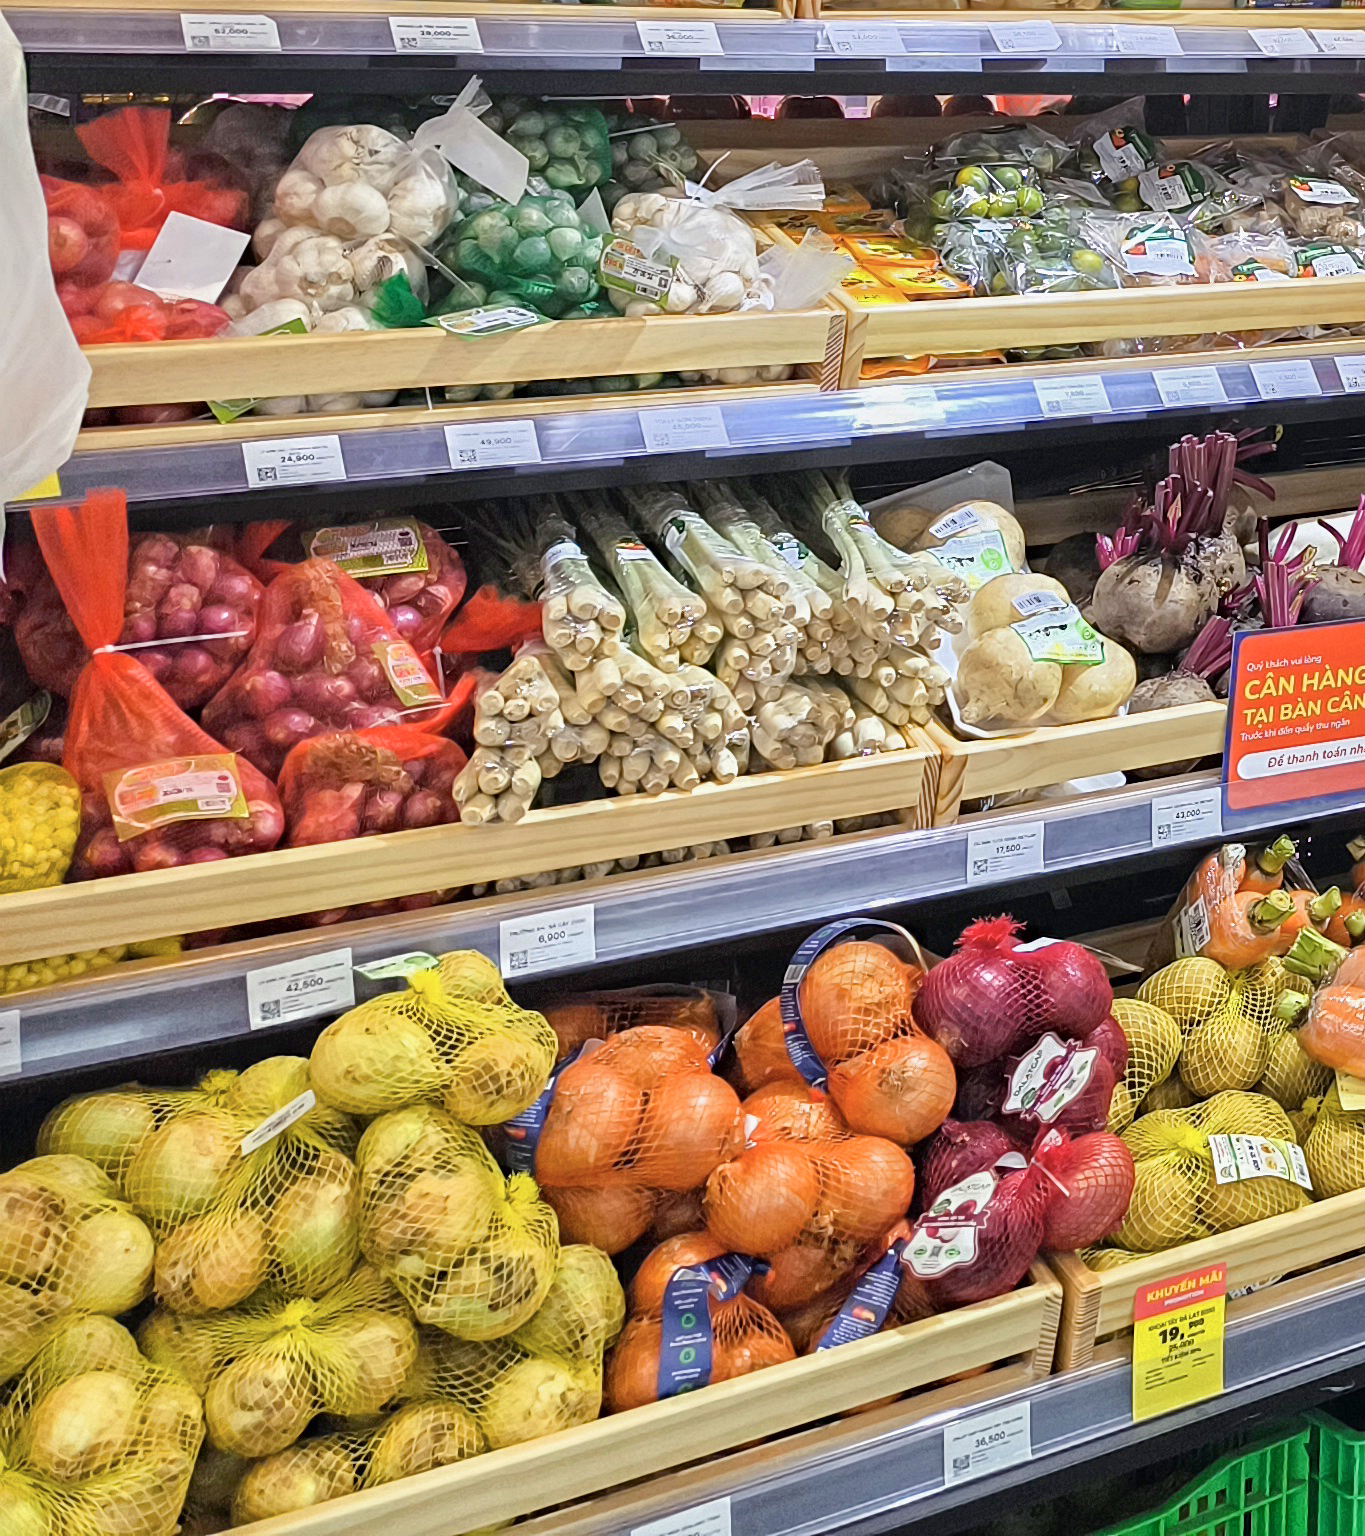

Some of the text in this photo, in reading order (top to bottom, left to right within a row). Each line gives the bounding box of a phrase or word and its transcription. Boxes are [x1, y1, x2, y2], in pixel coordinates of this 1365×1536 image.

[1244, 672, 1295, 700] CÂN
[1243, 706, 1274, 728] TẠI
[1279, 698, 1321, 720] BÀN
[1287, 750, 1319, 765] thanh
[1323, 744, 1347, 760] toán
[1146, 1276, 1197, 1302] KHUYẾN
